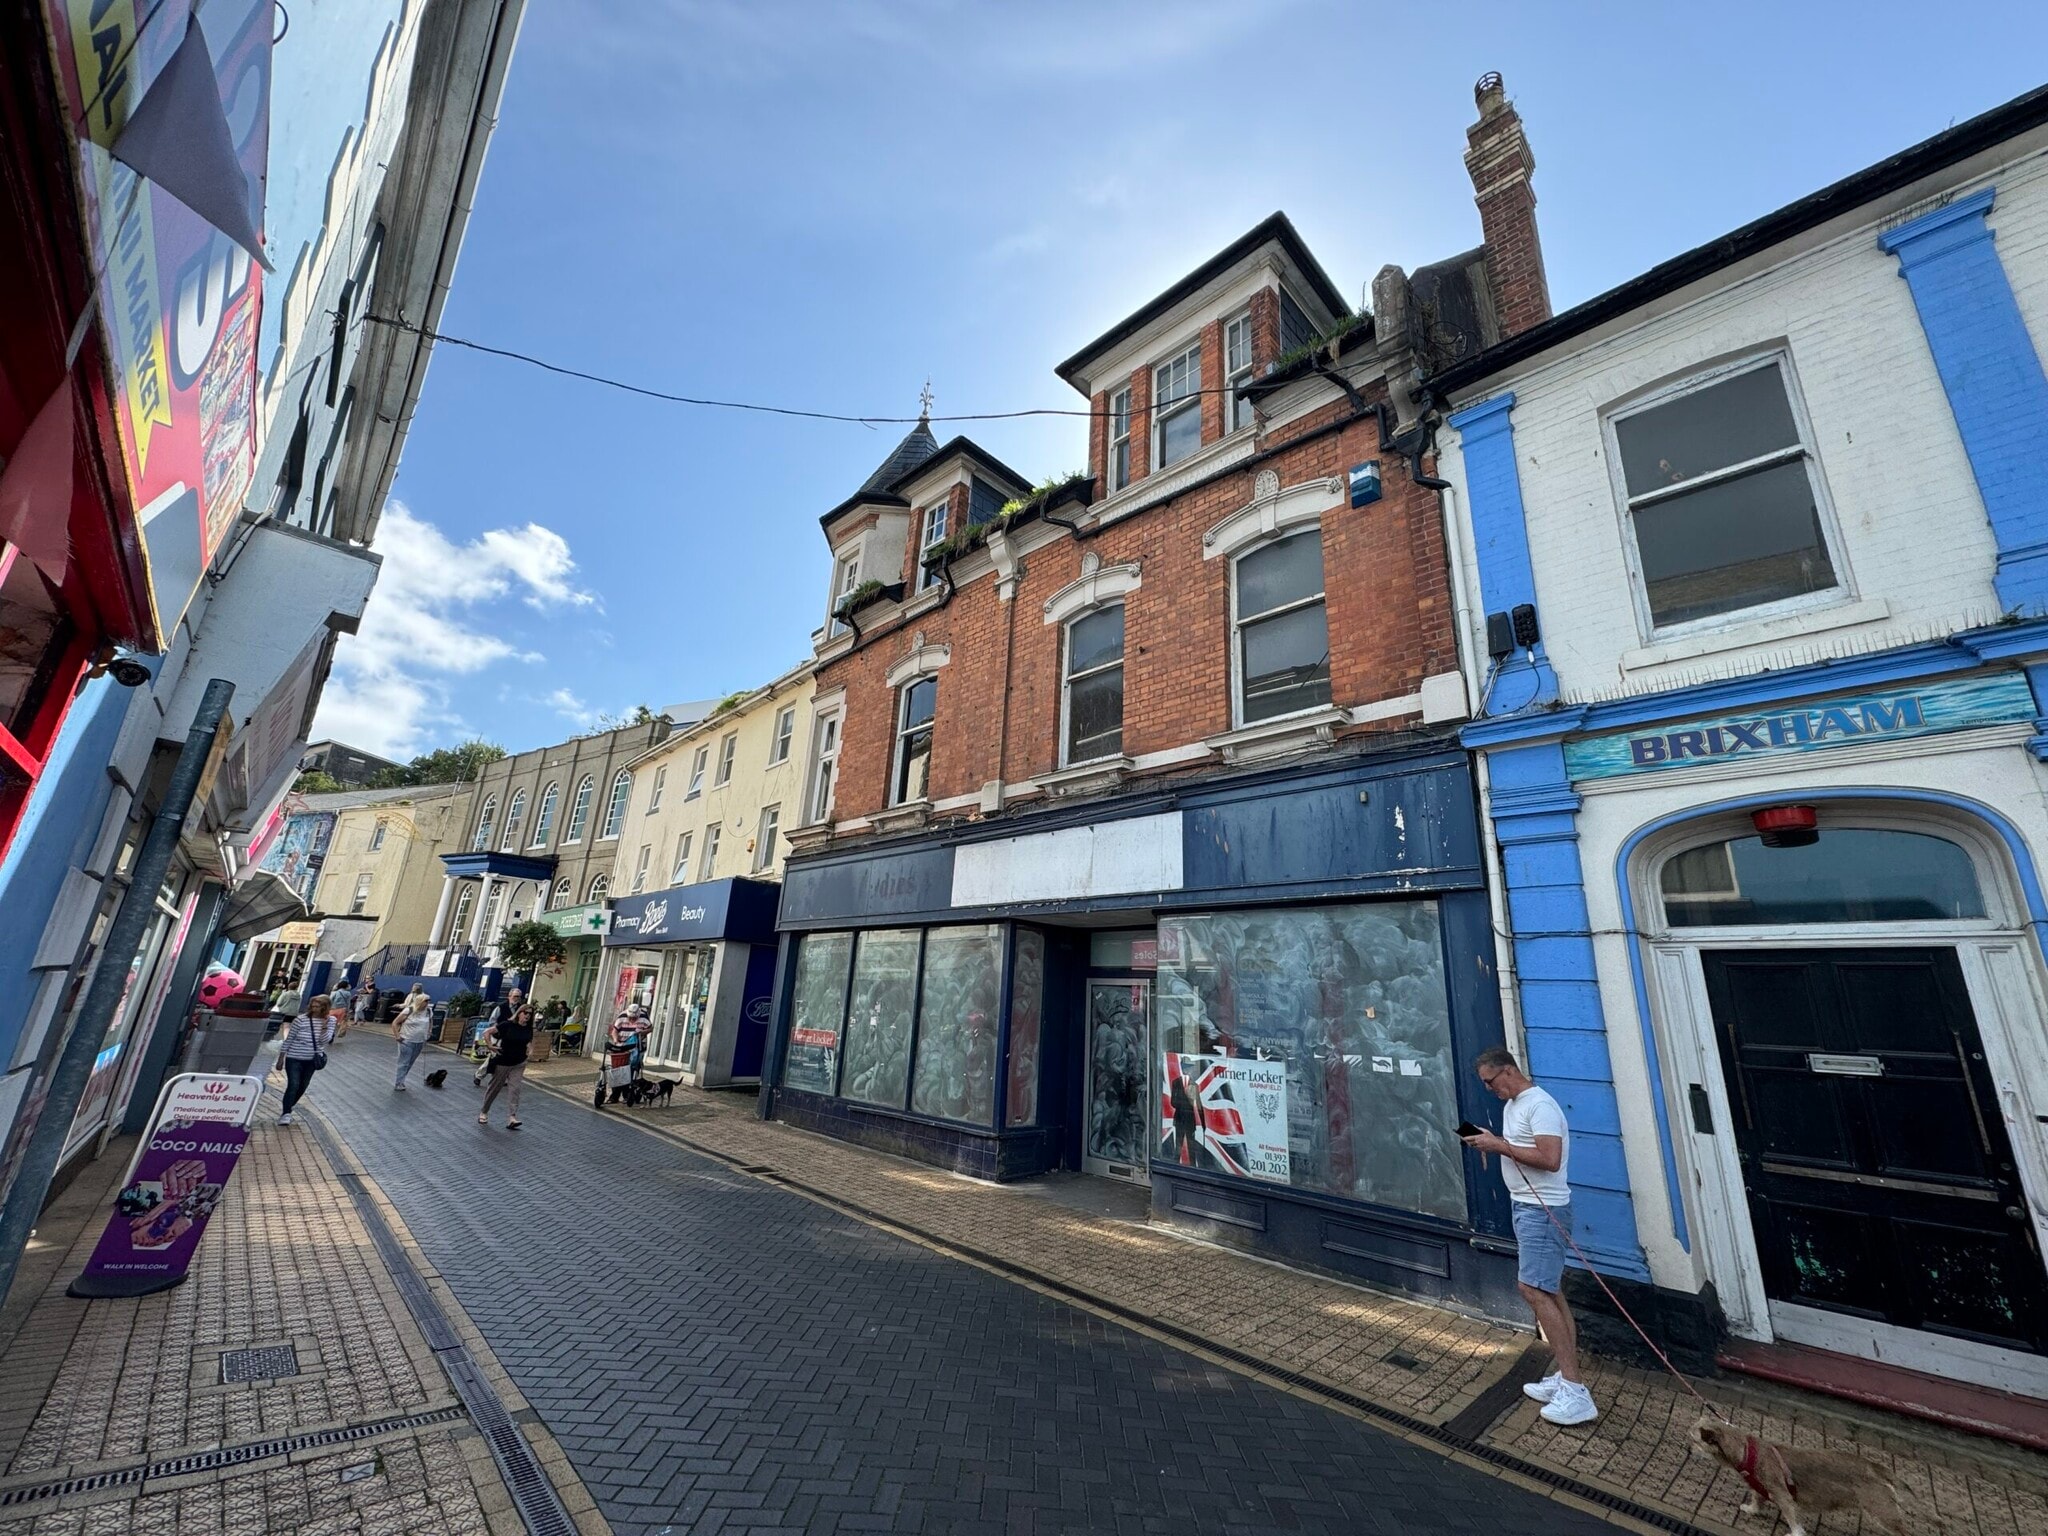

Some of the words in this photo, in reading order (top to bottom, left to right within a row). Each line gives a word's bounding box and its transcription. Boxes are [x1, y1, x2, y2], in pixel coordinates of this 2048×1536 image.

[125, 253, 160, 424] MARKET
[1630, 697, 1926, 765] BRIXHAM
[615, 914, 640, 931] Pharmacy
[639, 899, 668, 935] Boots
[681, 905, 706, 924] Beauty
[1213, 1066, 1247, 1082] Turner
[1248, 1069, 1284, 1085] Locker
[1249, 1083, 1282, 1092] BARNFIELD
[177, 1092, 221, 1102] Heavenly
[222, 1094, 246, 1102] Soles
[207, 1107, 240, 1115] pedicure
[150, 1139, 197, 1151] COCO
[200, 1142, 244, 1154] NAILS
[1264, 1152, 1287, 1163] 01392
[1250, 1159, 1266, 1172] 201
[1269, 1162, 1288, 1175] 202
